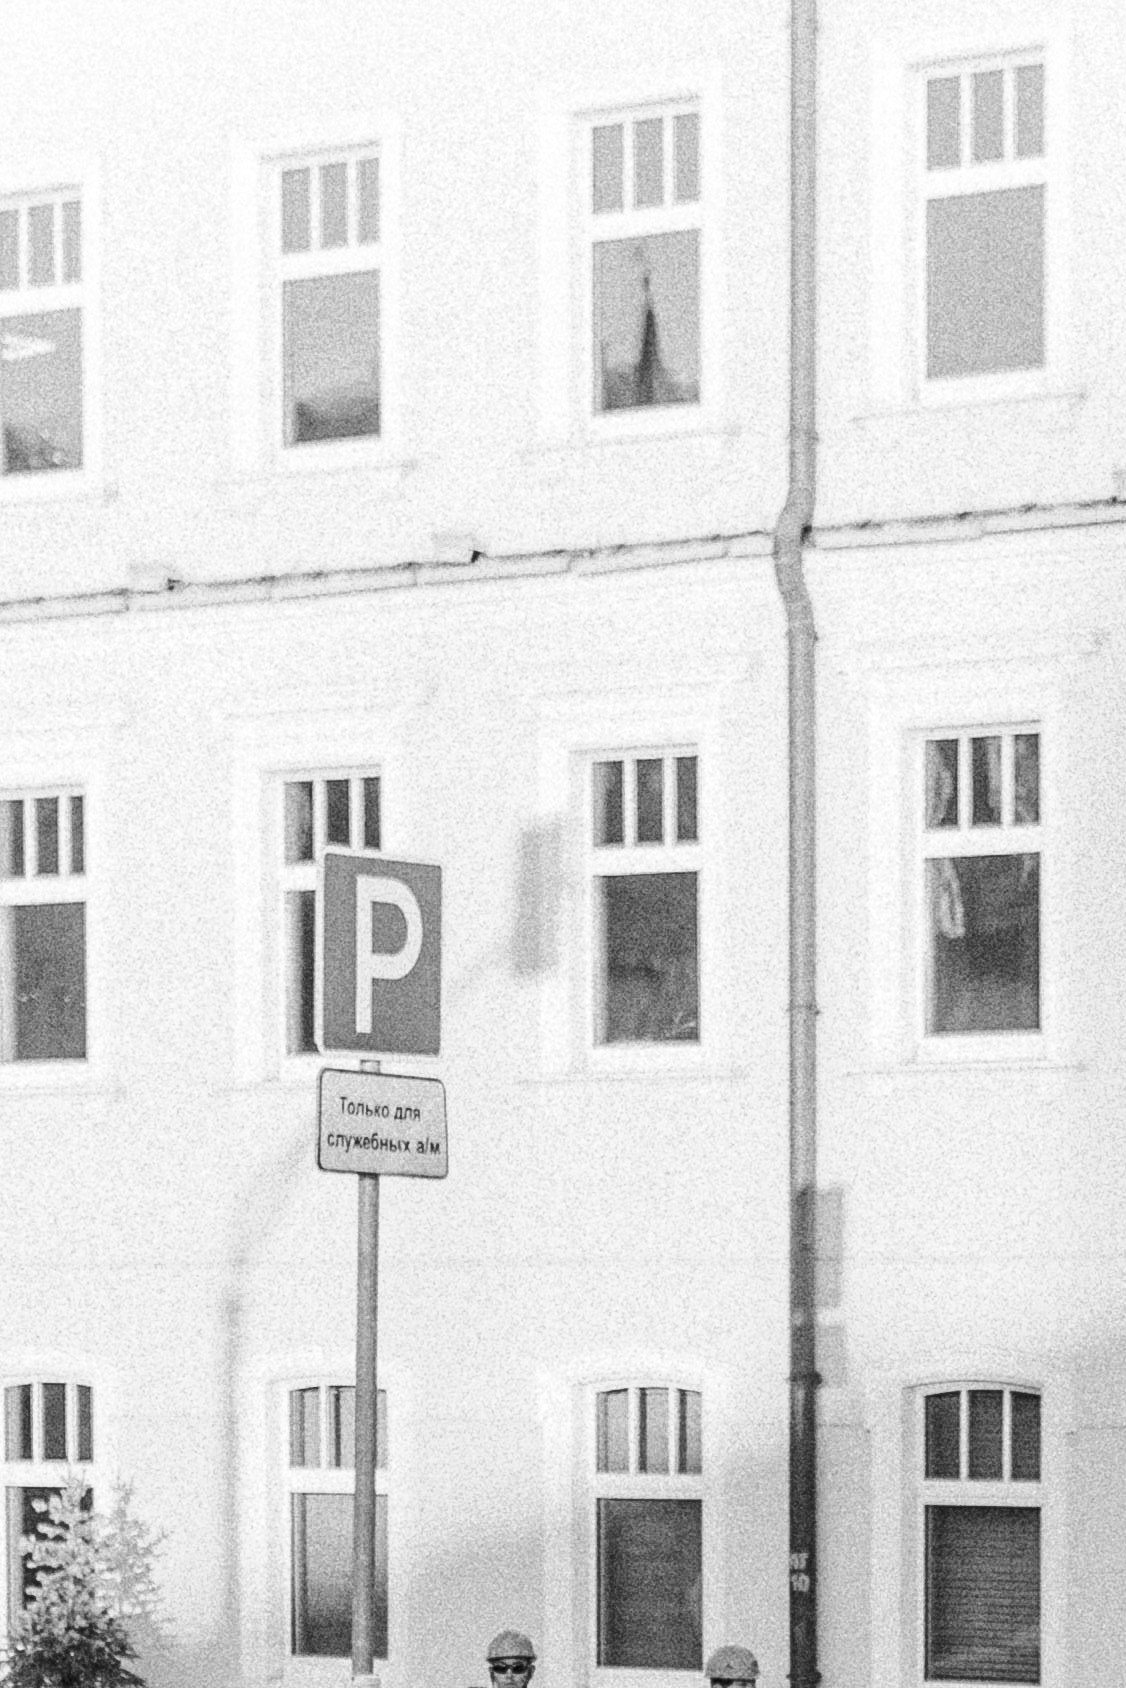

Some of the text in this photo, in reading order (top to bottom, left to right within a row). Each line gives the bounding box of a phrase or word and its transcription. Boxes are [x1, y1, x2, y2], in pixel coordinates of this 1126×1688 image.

[355, 873, 423, 1034] P
[340, 1096, 421, 1121] Только для
[327, 1132, 441, 1155] служебных а/м
